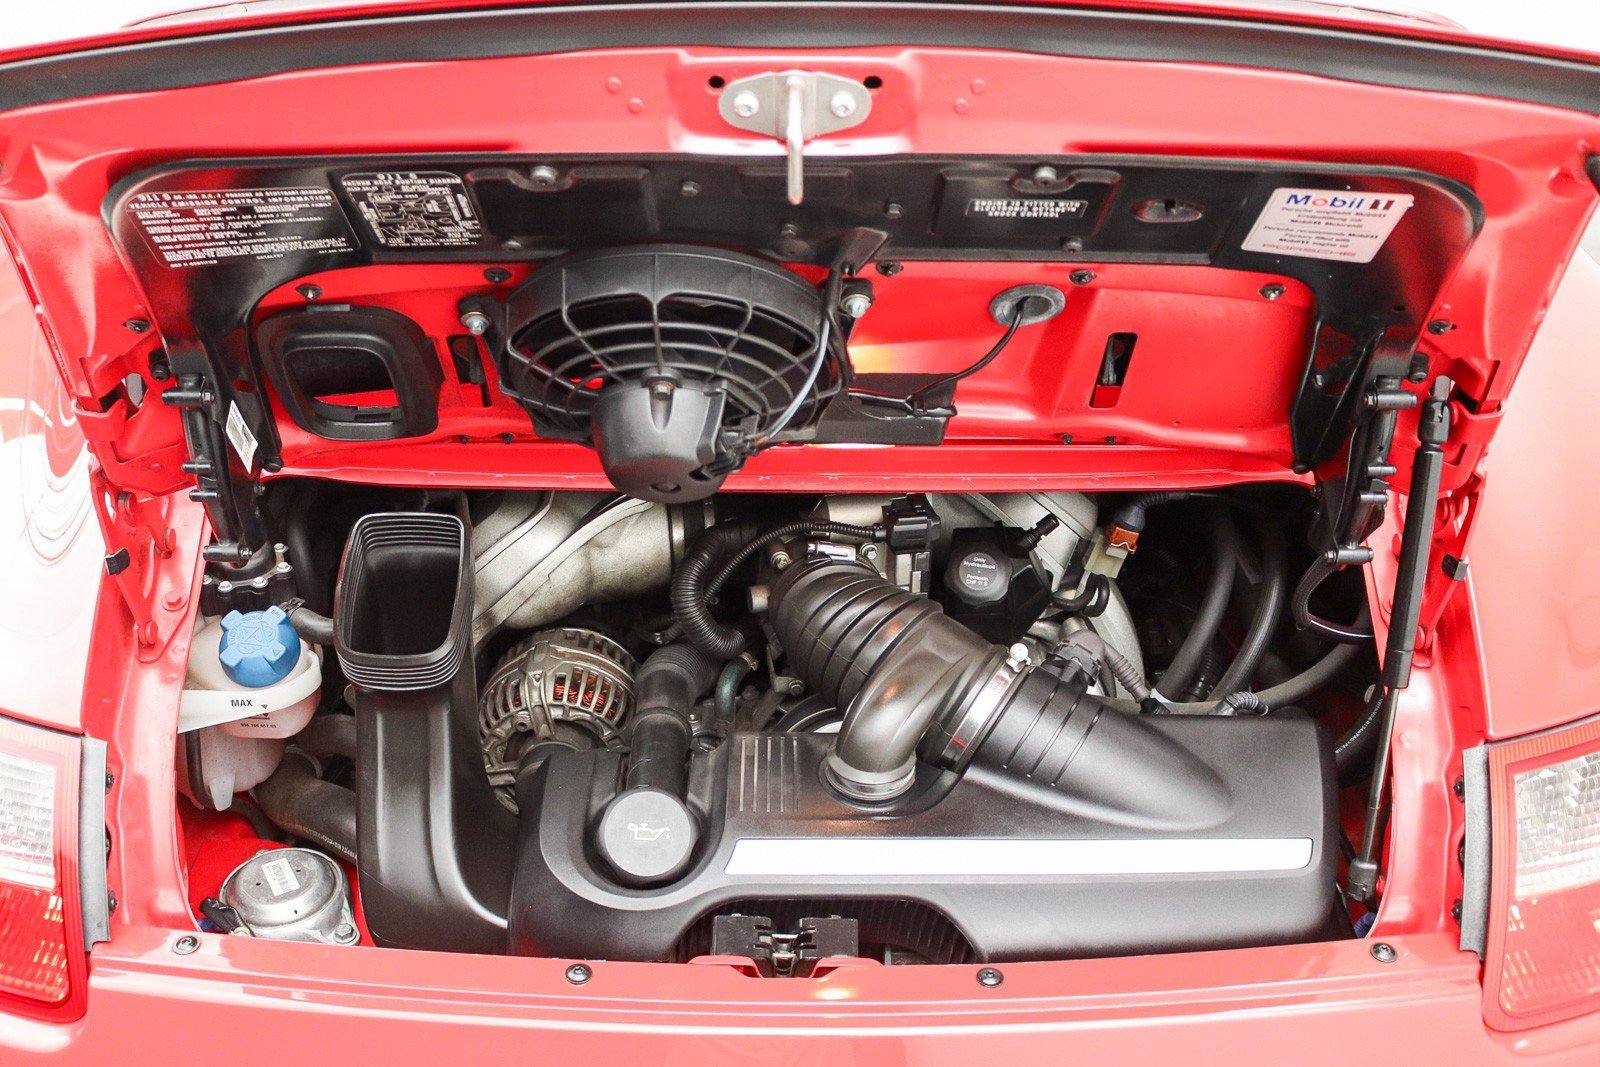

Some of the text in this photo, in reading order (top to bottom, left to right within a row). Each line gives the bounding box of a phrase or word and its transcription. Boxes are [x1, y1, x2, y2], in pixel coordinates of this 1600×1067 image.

[128, 195, 332, 209] VEHICLE EMISSION CONTROL INFORMATION
[138, 193, 160, 201] 911
[1286, 194, 1364, 209] Mobil
[1262, 243, 1356, 256] PORSCHE
[231, 699, 253, 707] MAX
